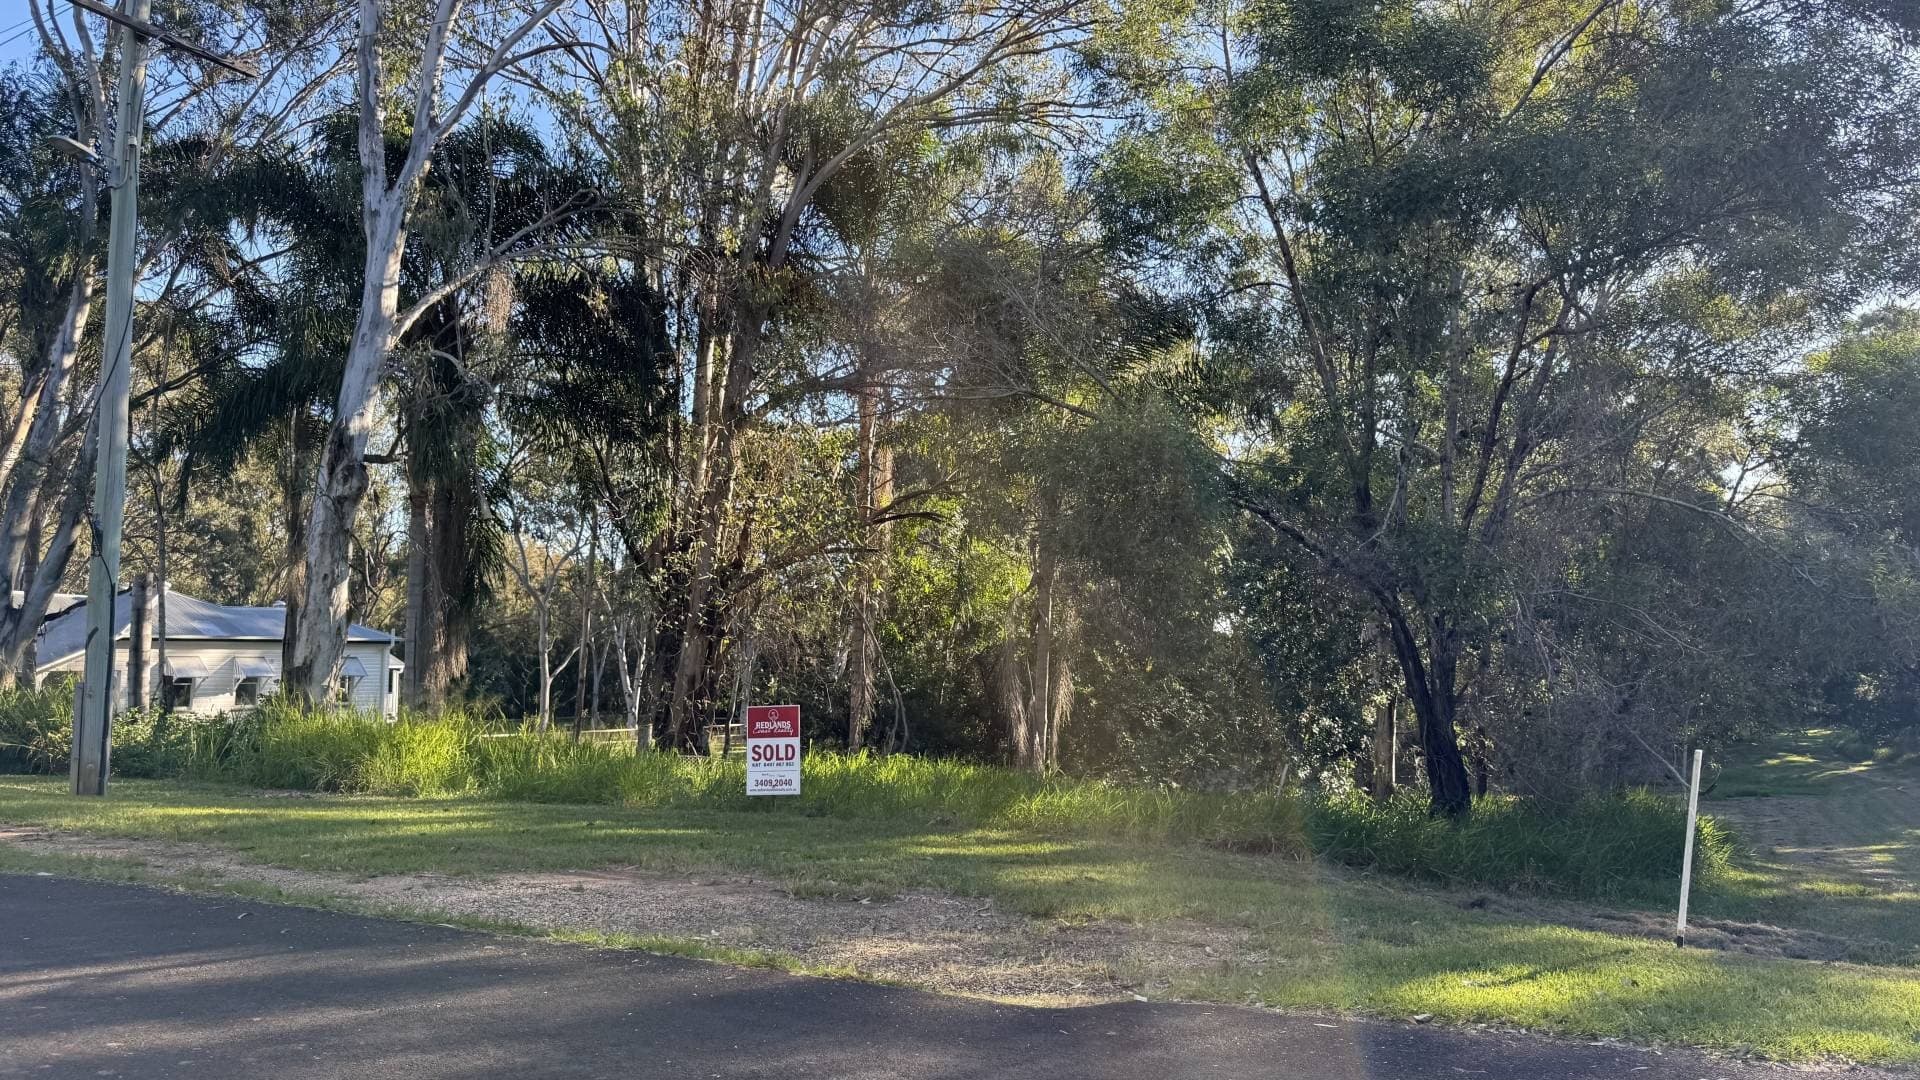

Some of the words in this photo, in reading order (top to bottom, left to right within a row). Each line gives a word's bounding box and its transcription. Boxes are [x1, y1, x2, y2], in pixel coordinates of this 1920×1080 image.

[755, 720, 791, 729] REDLANDS
[751, 744, 795, 761] SOLD
[754, 779, 773, 787] 3409
[774, 779, 792, 787] 2040
